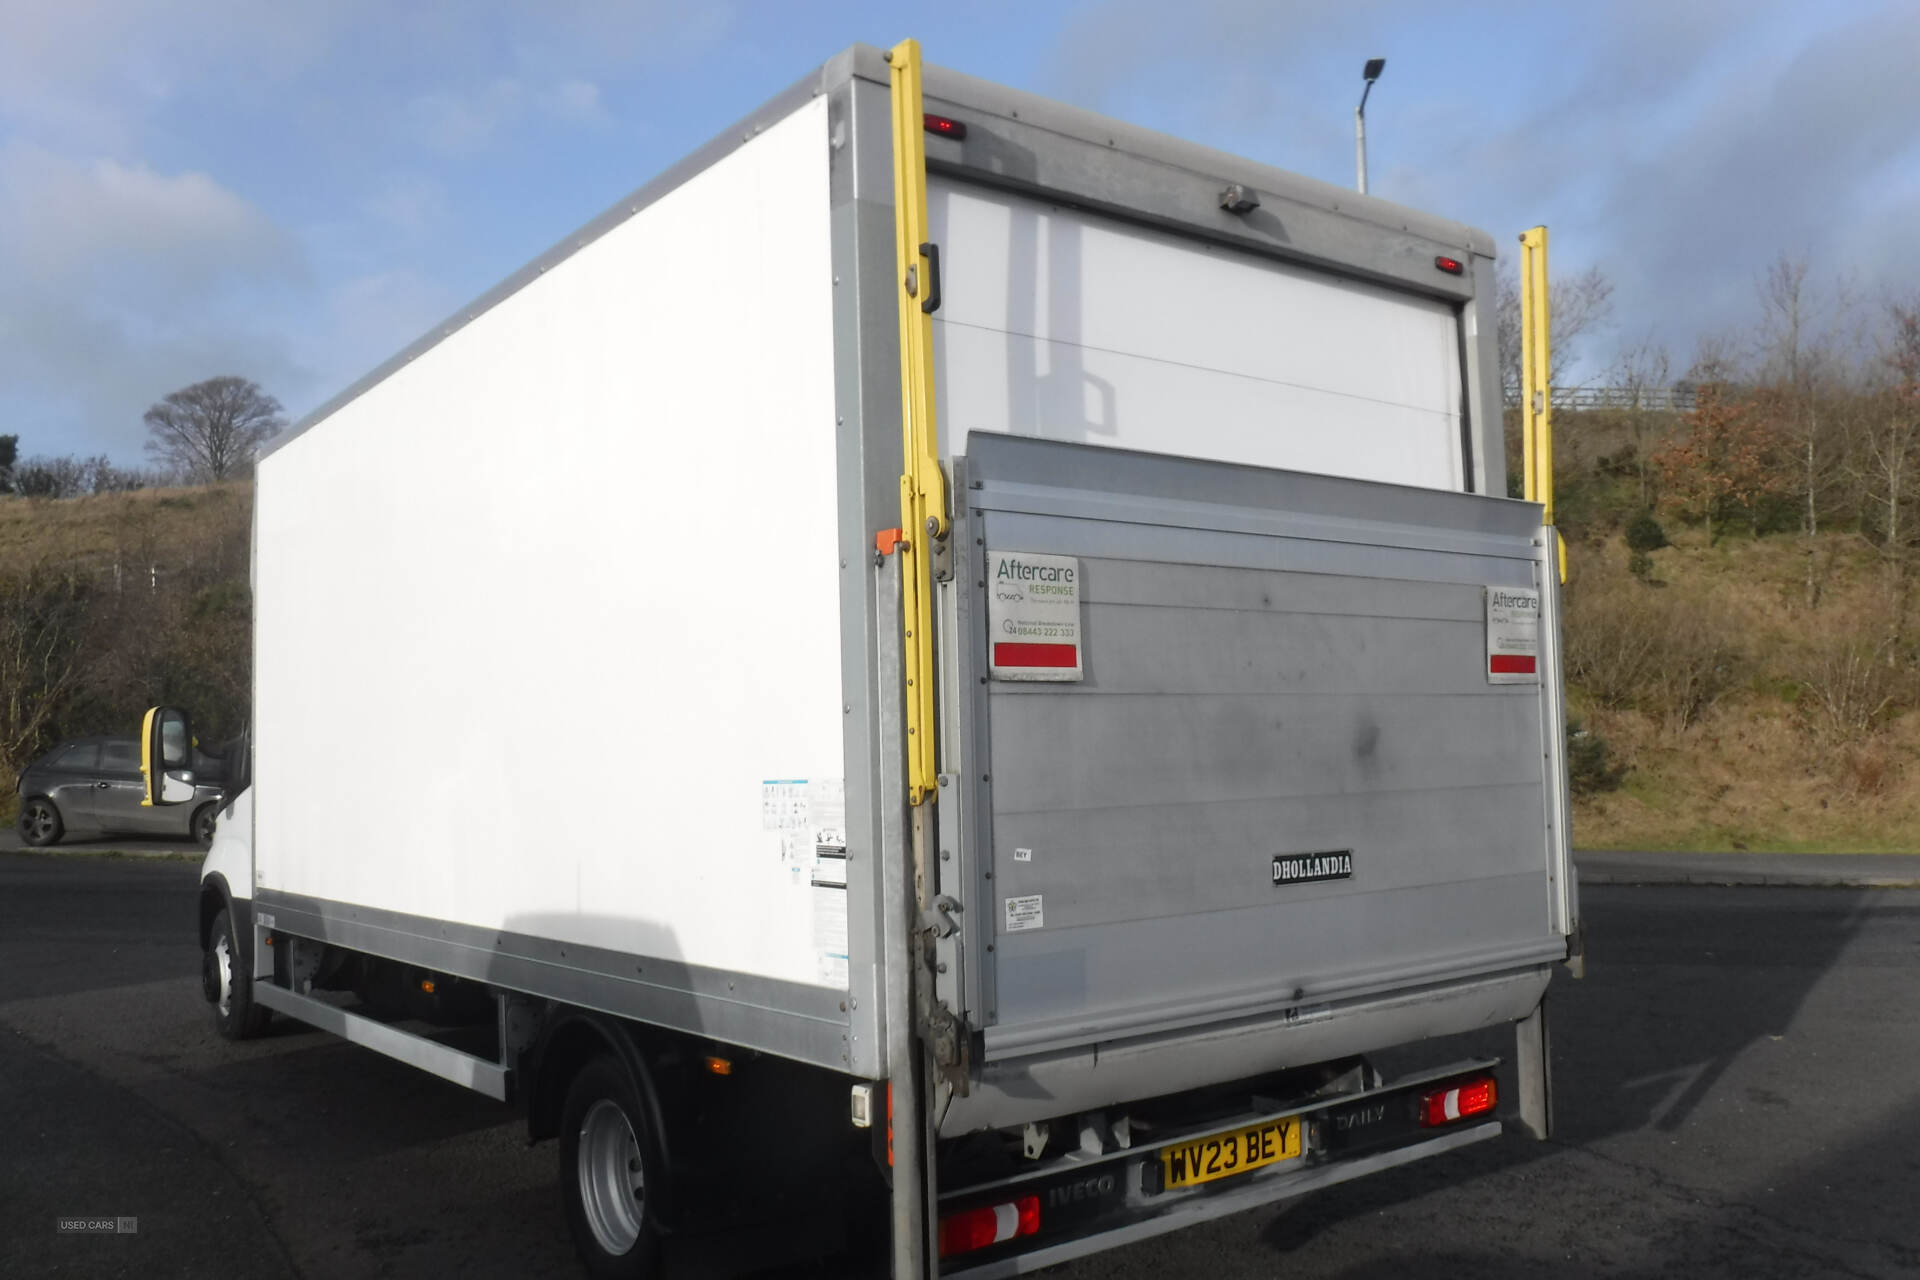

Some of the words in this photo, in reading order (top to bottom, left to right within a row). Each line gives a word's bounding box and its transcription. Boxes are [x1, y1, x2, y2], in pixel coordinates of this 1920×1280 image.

[997, 558, 1074, 582] Aftercare
[1029, 584, 1074, 596] RESPONSE
[1492, 591, 1537, 609] Aftercare
[1272, 855, 1352, 880] DHOLLANDIA
[1336, 1104, 1385, 1131] DAILY
[1170, 1136, 1238, 1184] WV23
[1245, 1121, 1290, 1164] BEY
[1048, 1174, 1114, 1208] IVECO
